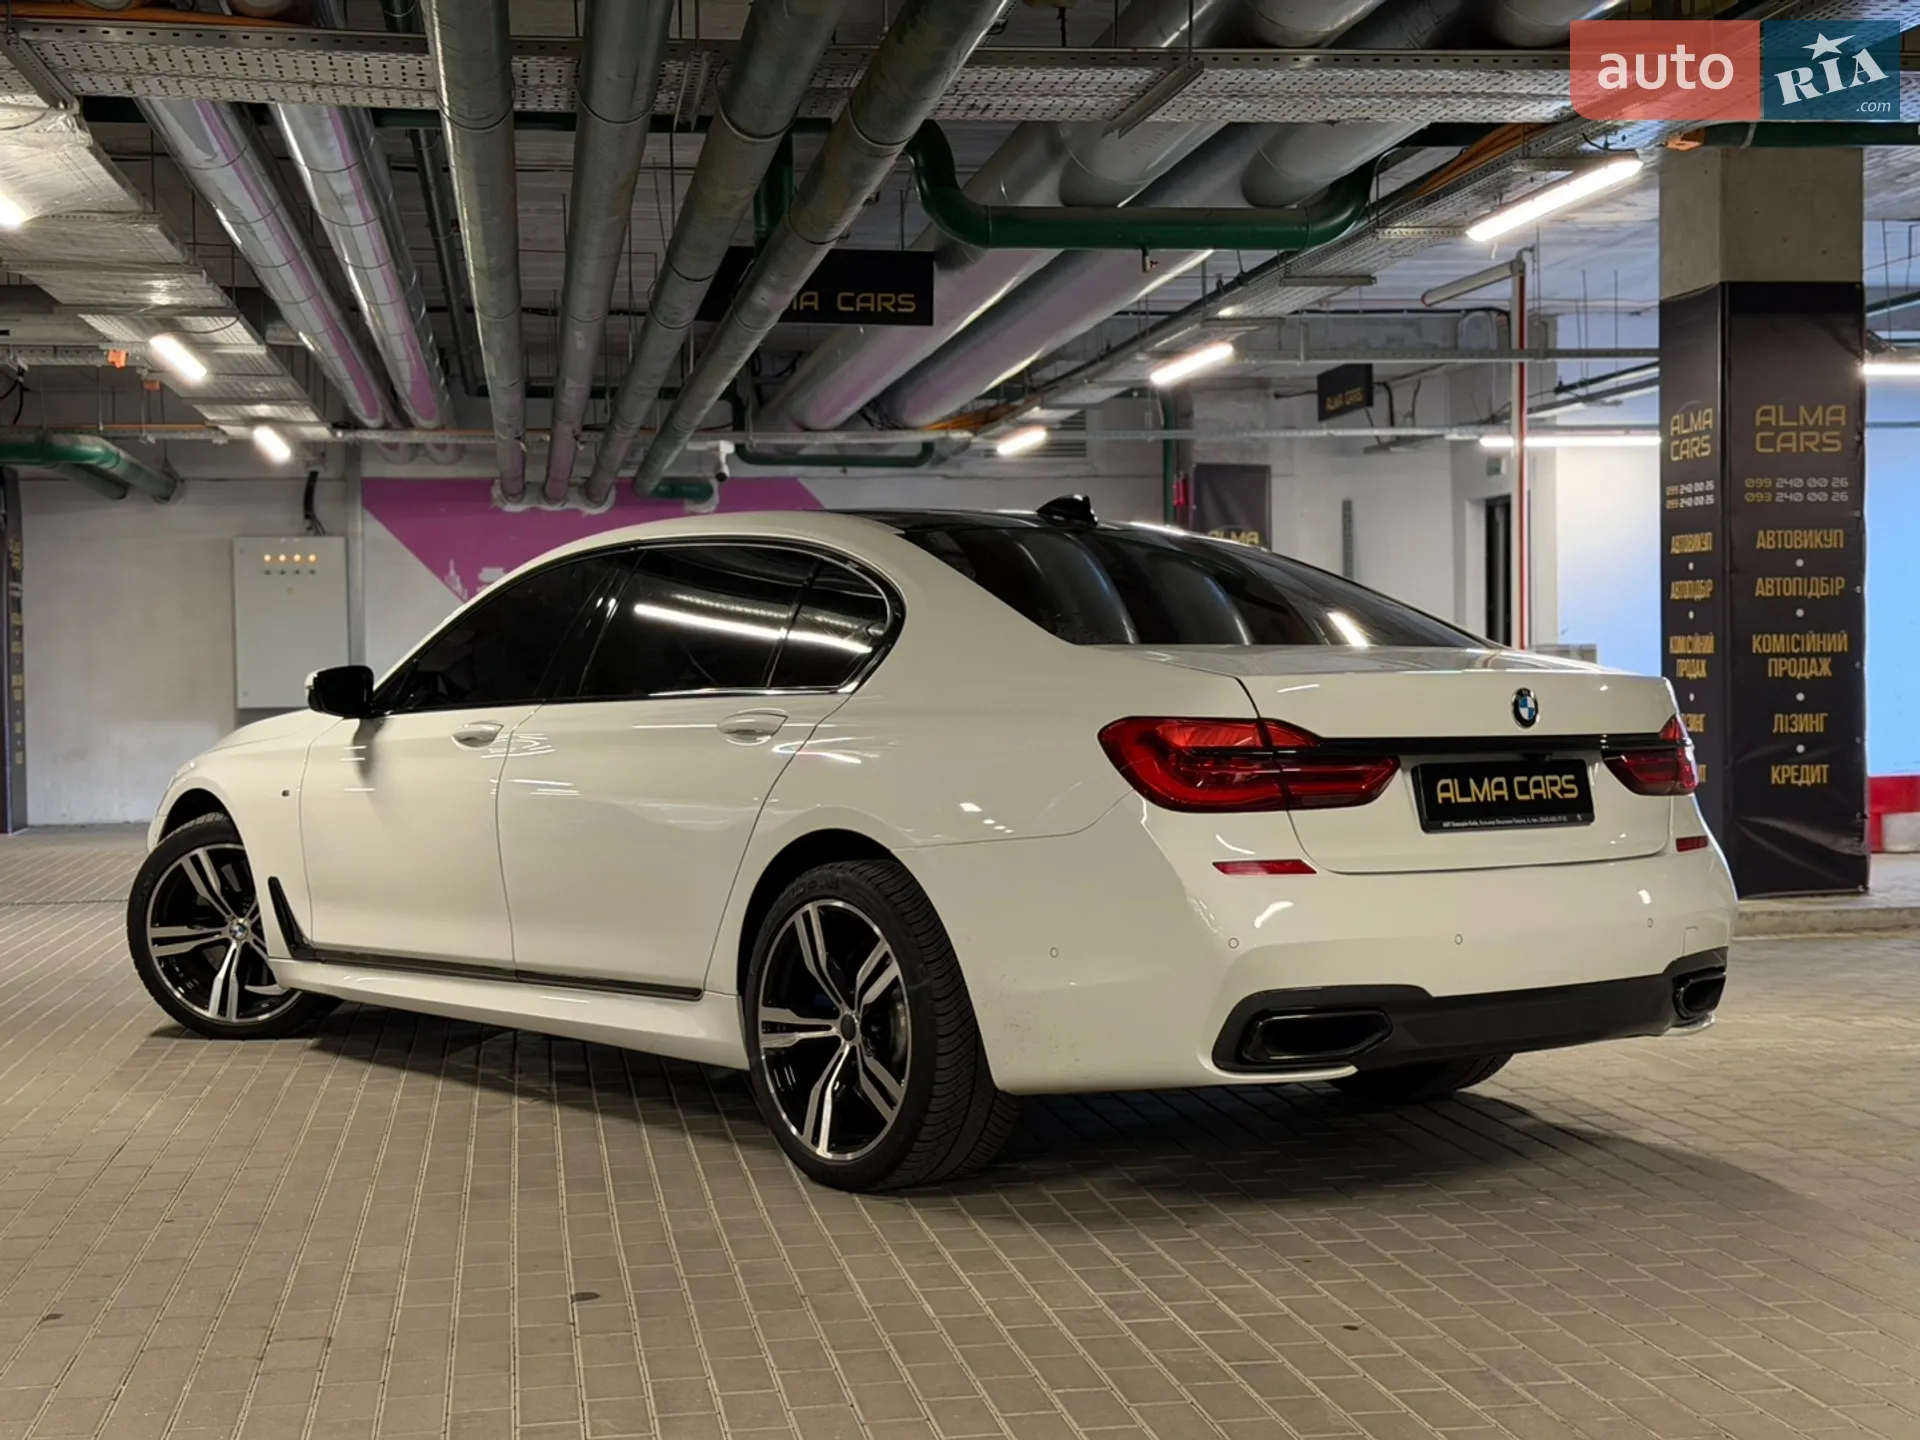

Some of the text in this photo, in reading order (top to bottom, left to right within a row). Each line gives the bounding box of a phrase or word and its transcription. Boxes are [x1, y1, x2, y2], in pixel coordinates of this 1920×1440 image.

[836, 292, 917, 313] CARS
[1670, 408, 1713, 436] ALMA
[1755, 404, 1847, 427] ALMA
[1670, 434, 1711, 461] CARS
[1755, 431, 1842, 453] CARS
[1744, 477, 1849, 488] 099 240 00 26
[1744, 491, 1849, 503] 093 240 00 26
[1756, 529, 1844, 550] АВТОВИКУП
[1755, 577, 1845, 599] АВТОПІДБІР
[1752, 630, 1848, 653] КОМІСІЙНИЙ
[1768, 657, 1832, 679] ПРОДАЖ
[1773, 713, 1828, 733] ЛІЗИНГ
[1771, 764, 1830, 787] КРЕДИТ
[1436, 774, 1579, 804] ALMA CARS
